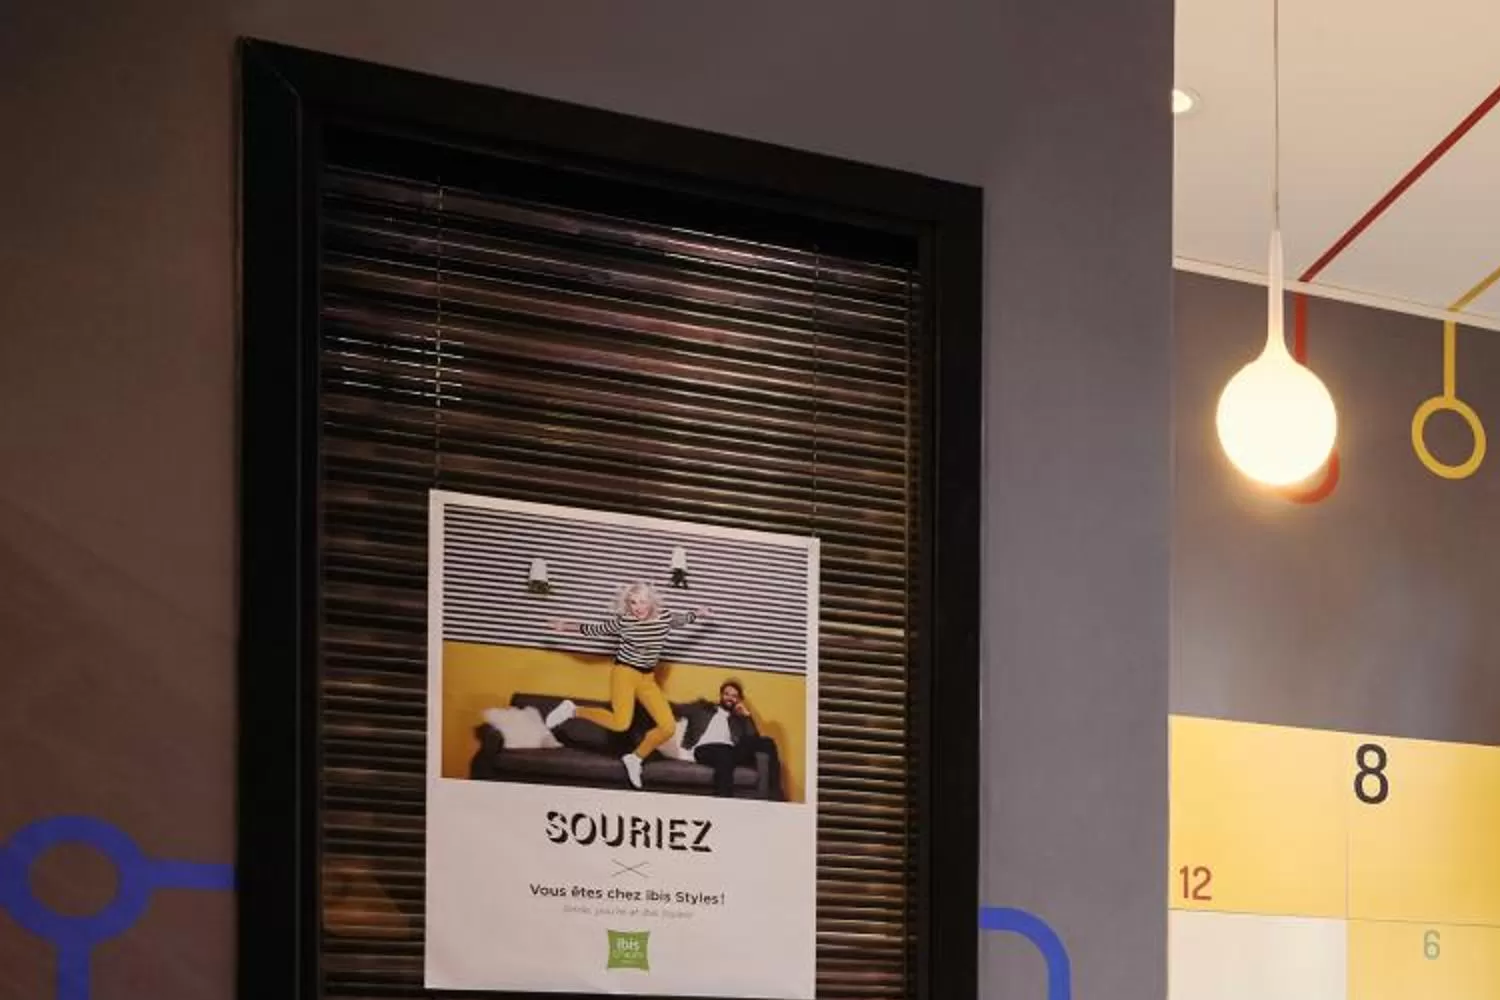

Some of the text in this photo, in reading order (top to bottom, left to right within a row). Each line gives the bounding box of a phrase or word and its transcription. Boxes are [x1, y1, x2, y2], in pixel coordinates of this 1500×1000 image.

[1353, 743, 1389, 804] 8
[545, 811, 713, 852] SOURIEZ
[529, 883, 567, 897] Vous
[571, 886, 603, 899] êtes
[607, 887, 641, 901] chez
[1178, 865, 1213, 901] 12
[616, 937, 640, 951] ibis
[1423, 930, 1441, 960] 6
